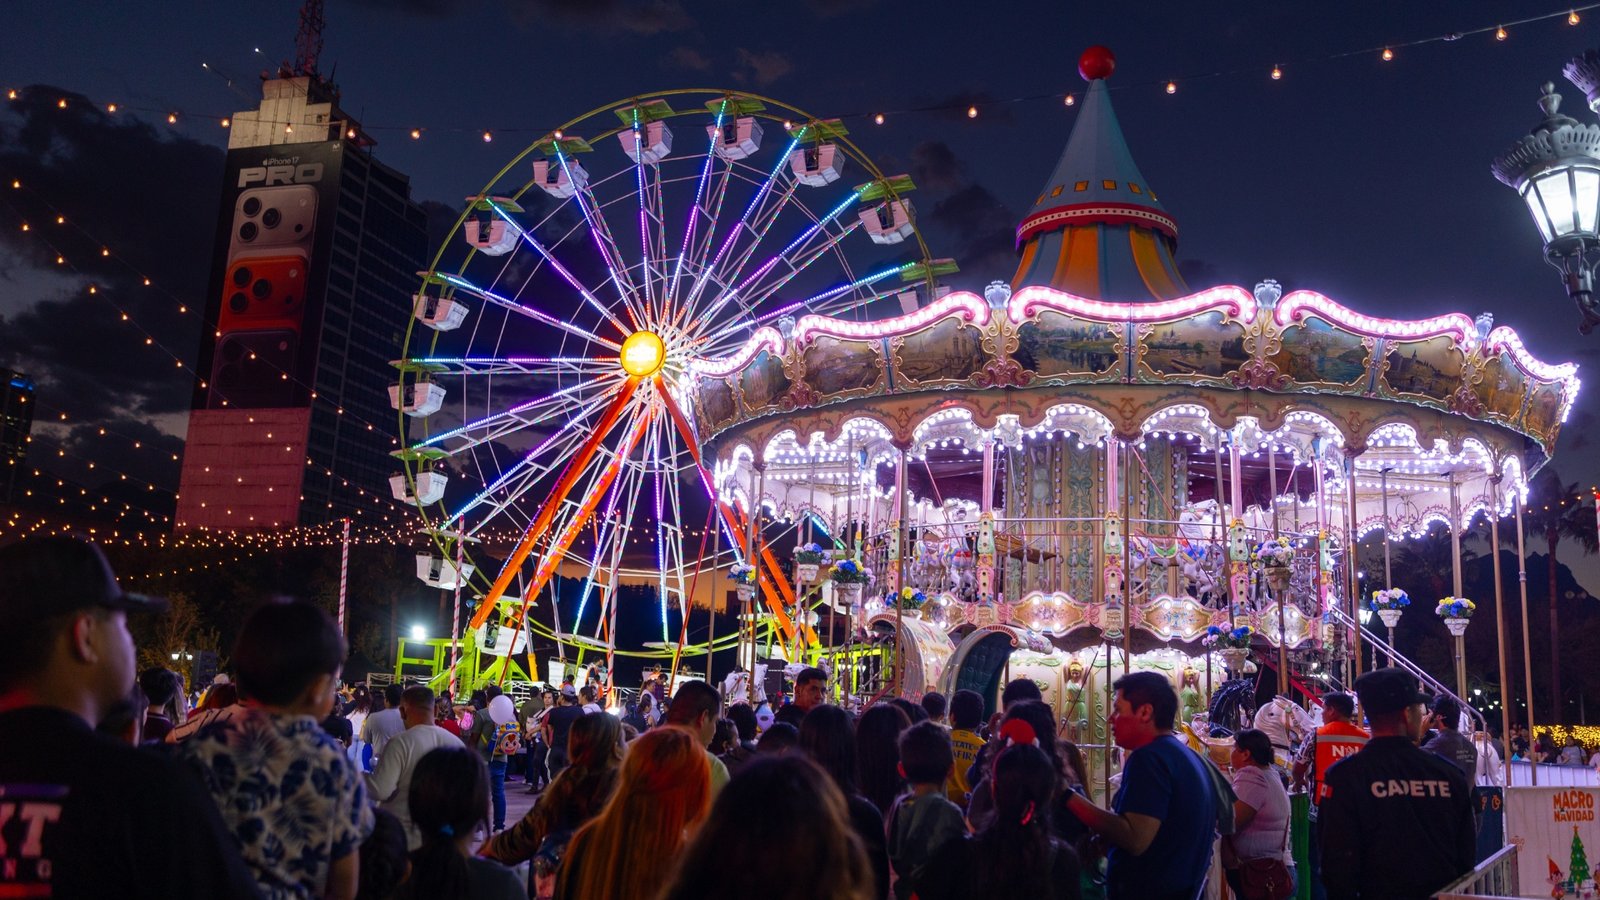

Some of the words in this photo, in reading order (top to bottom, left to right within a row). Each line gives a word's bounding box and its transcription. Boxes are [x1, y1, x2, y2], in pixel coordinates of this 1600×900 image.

[268, 157, 291, 166] iPhone
[292, 156, 300, 165] 17
[237, 162, 324, 188] PRO
[1553, 790, 1594, 809] MACRO
[1554, 810, 1594, 822] NAVIDAD
